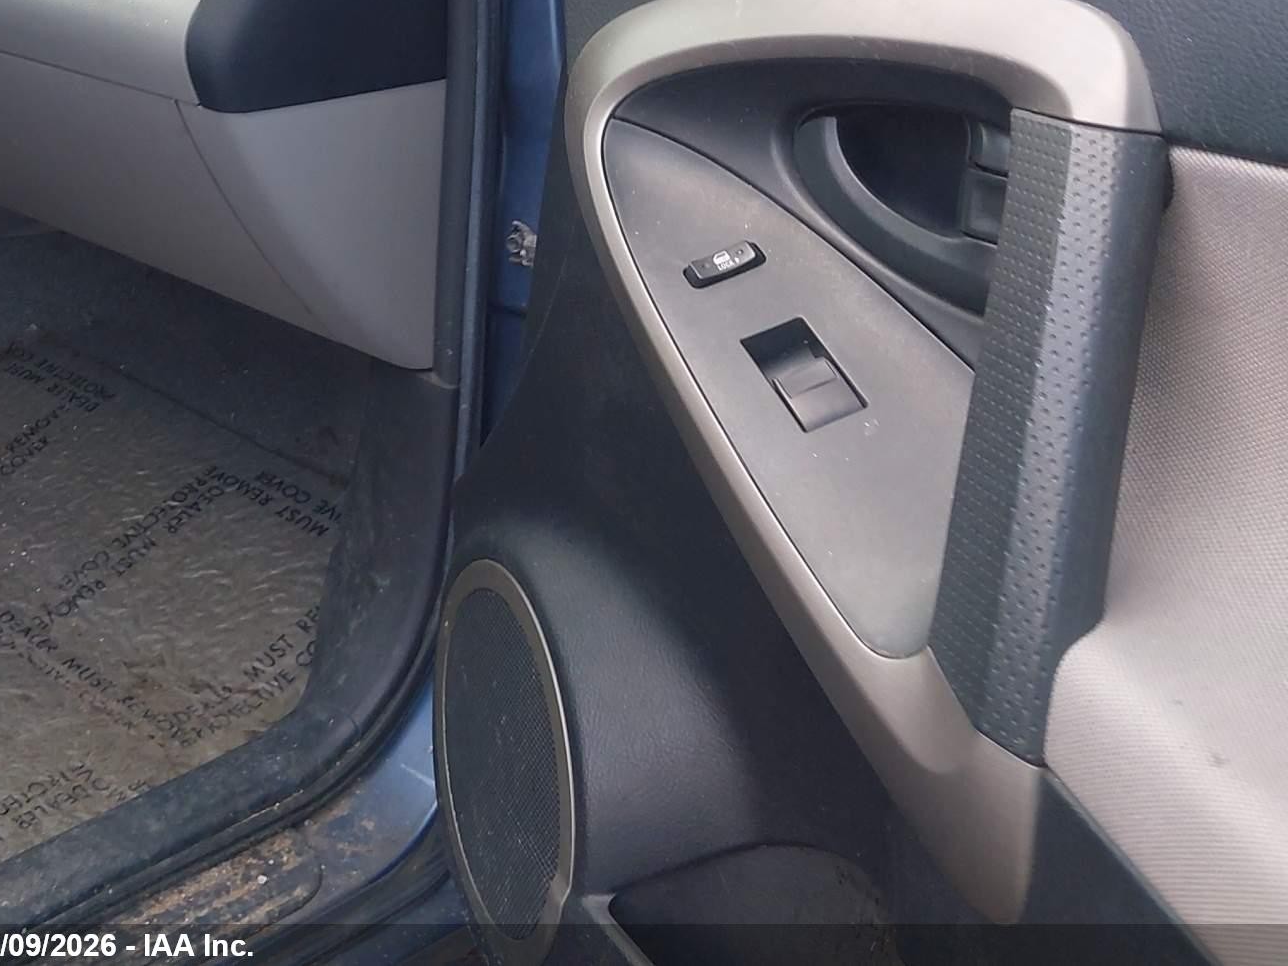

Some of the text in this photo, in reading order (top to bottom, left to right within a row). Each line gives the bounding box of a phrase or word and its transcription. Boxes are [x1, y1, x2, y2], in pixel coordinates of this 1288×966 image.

[207, 465, 331, 537] MUST REMOVE
[253, 470, 312, 504] COVER
[30, 484, 224, 633] DEALER MUST REMOVE
[57, 550, 111, 591] COVER
[241, 633, 295, 684] MUST
[294, 605, 321, 635] RE
[61, 657, 117, 694] MUST
[16, 782, 90, 830] DEALER
